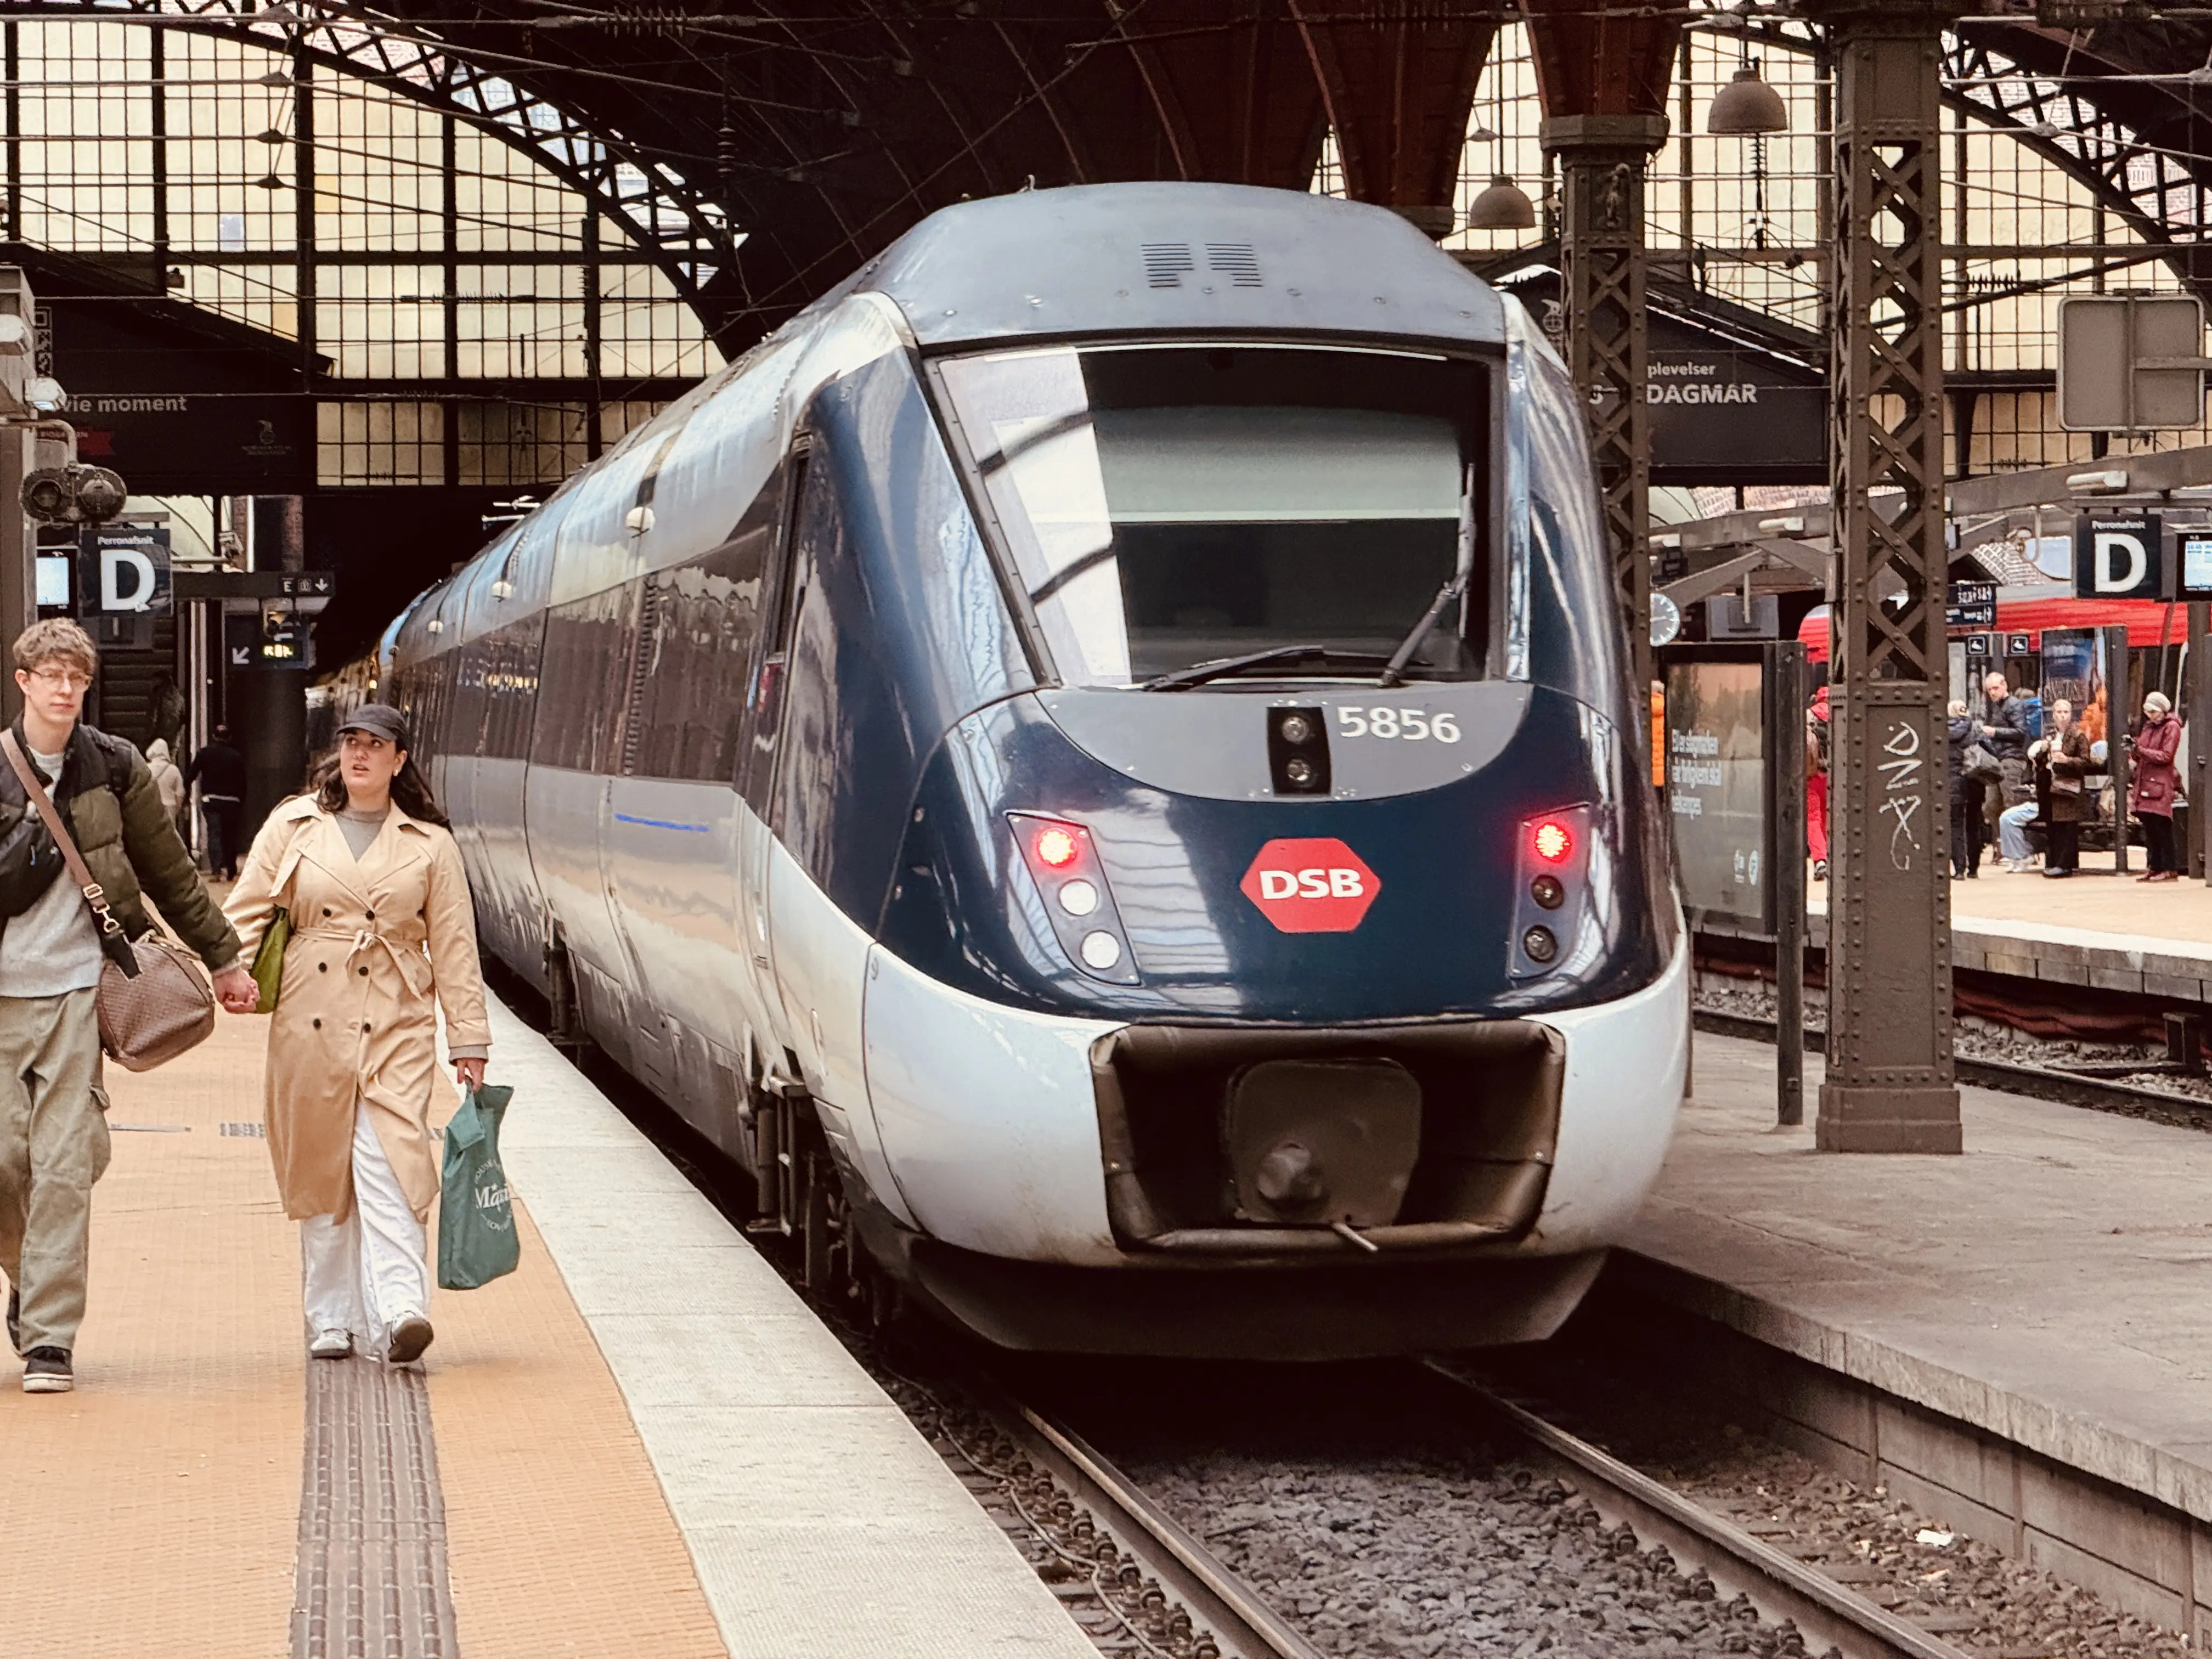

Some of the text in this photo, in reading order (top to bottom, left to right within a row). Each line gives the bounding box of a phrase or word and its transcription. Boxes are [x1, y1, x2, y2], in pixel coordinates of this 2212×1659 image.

[1647, 362, 1717, 379] plevelser
[97, 395, 188, 412] moment
[1646, 384, 1757, 404] DAGMAR
[2095, 533, 2147, 592] D
[100, 549, 156, 611] D
[284, 580, 292, 592] E
[1337, 706, 1462, 743] 5856
[1260, 868, 1364, 900] DSB
